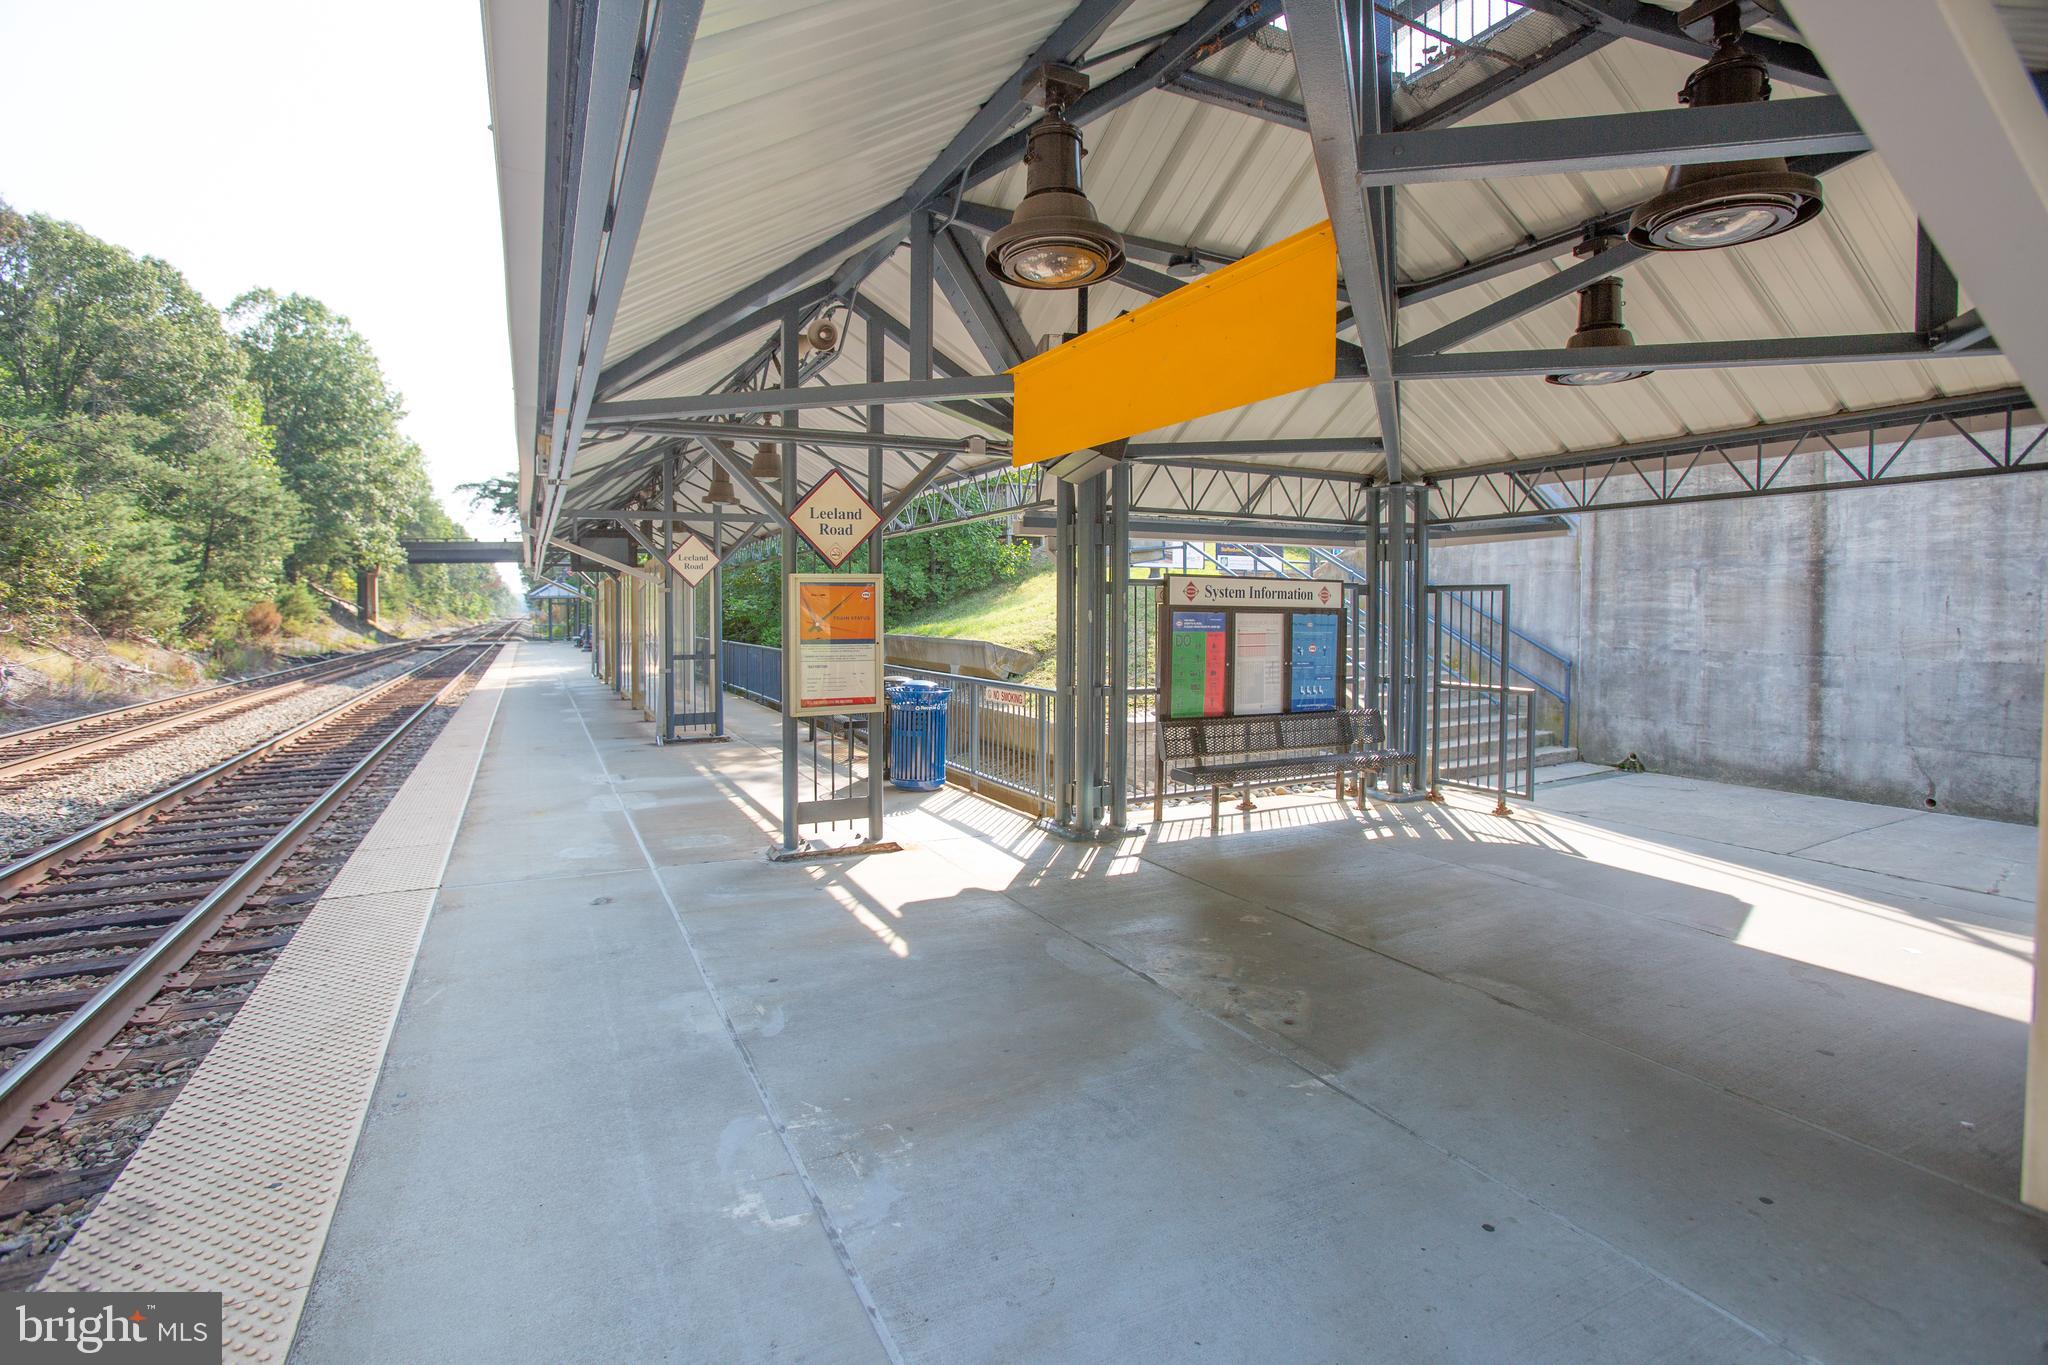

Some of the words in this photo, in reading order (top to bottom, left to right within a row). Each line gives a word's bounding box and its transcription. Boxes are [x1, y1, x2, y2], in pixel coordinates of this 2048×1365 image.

[810, 507, 862, 520] Leeland
[819, 523, 853, 536] Road
[1204, 584, 1246, 602] System
[1249, 586, 1314, 601] Information
[992, 690, 1000, 700] NO
[1001, 691, 1023, 704] SMOKING
